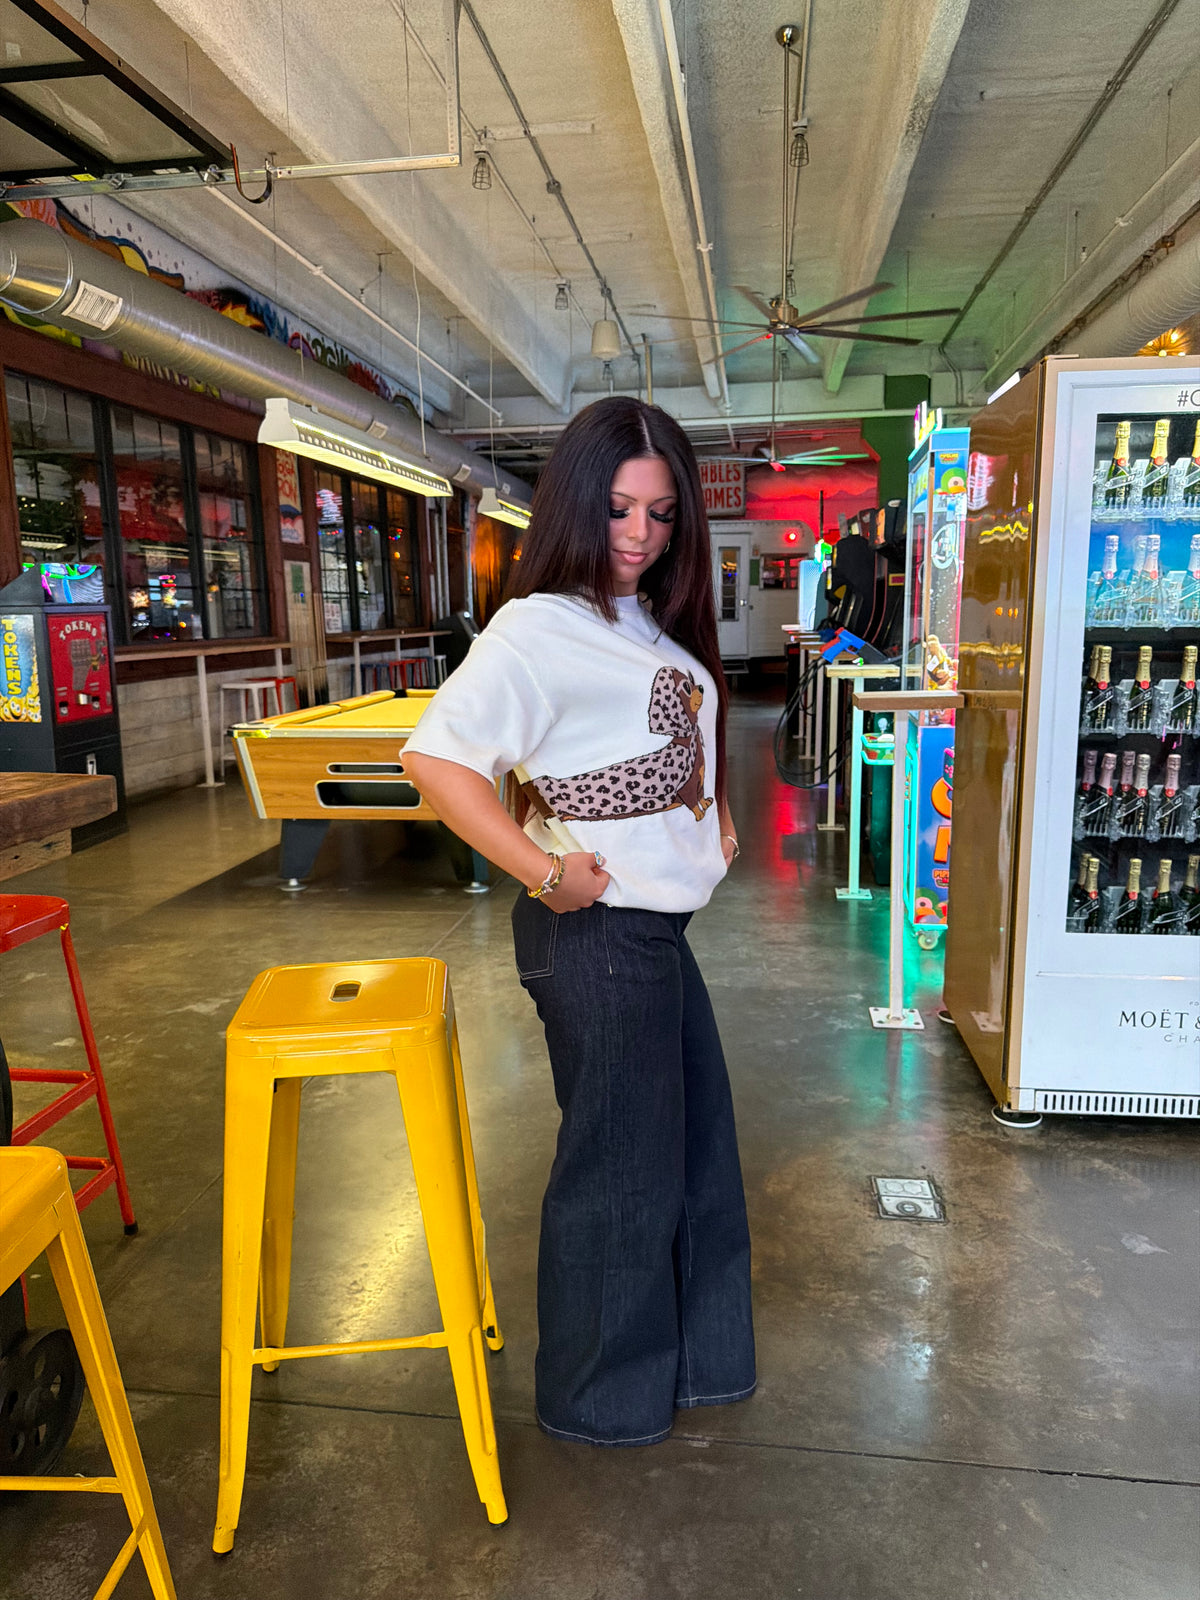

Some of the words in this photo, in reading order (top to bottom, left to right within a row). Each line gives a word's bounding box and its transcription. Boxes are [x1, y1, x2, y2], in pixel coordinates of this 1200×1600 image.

[59, 620, 98, 640] TOKENS
[1, 619, 23, 695] TOKENS
[1119, 1008, 1190, 1029] MOËT
